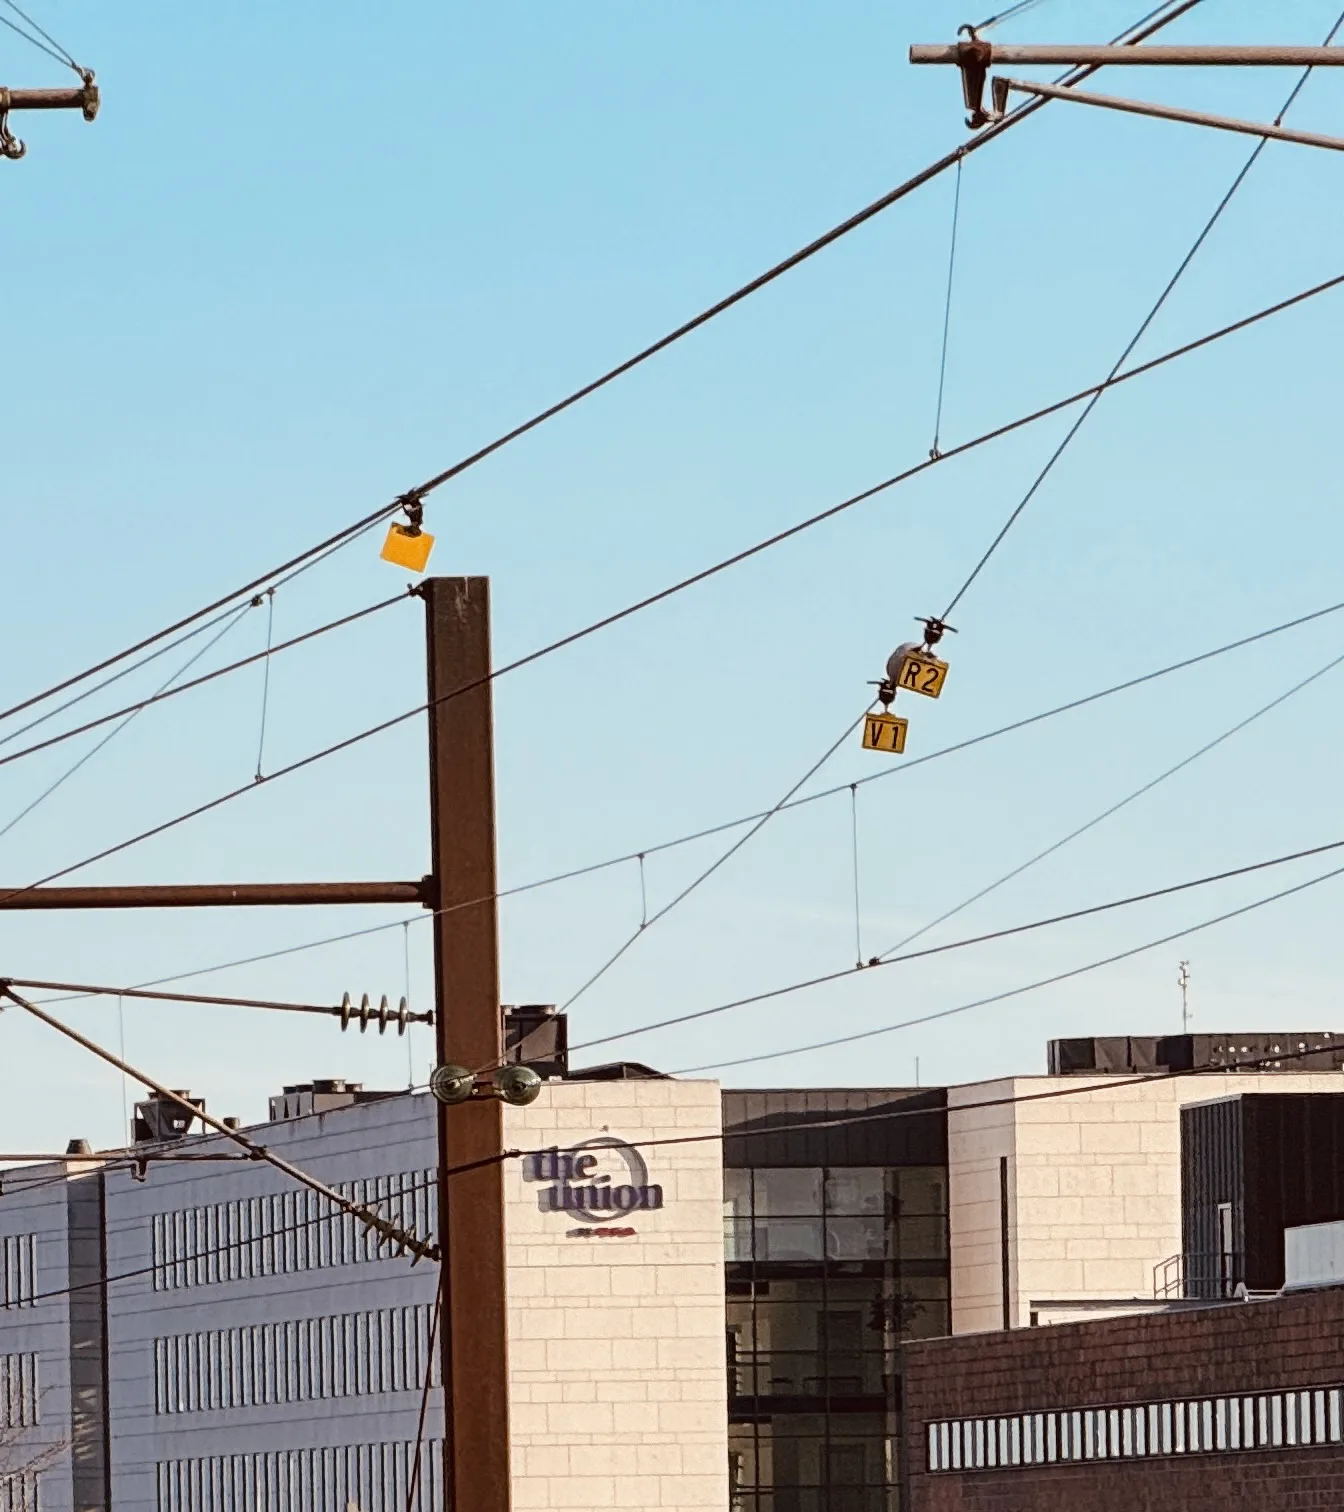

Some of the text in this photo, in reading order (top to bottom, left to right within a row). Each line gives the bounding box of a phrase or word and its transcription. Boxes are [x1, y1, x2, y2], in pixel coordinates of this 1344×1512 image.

[904, 661, 939, 693] R2
[871, 722, 900, 749] V1
[529, 1146, 598, 1180] the
[544, 1174, 663, 1211] union
